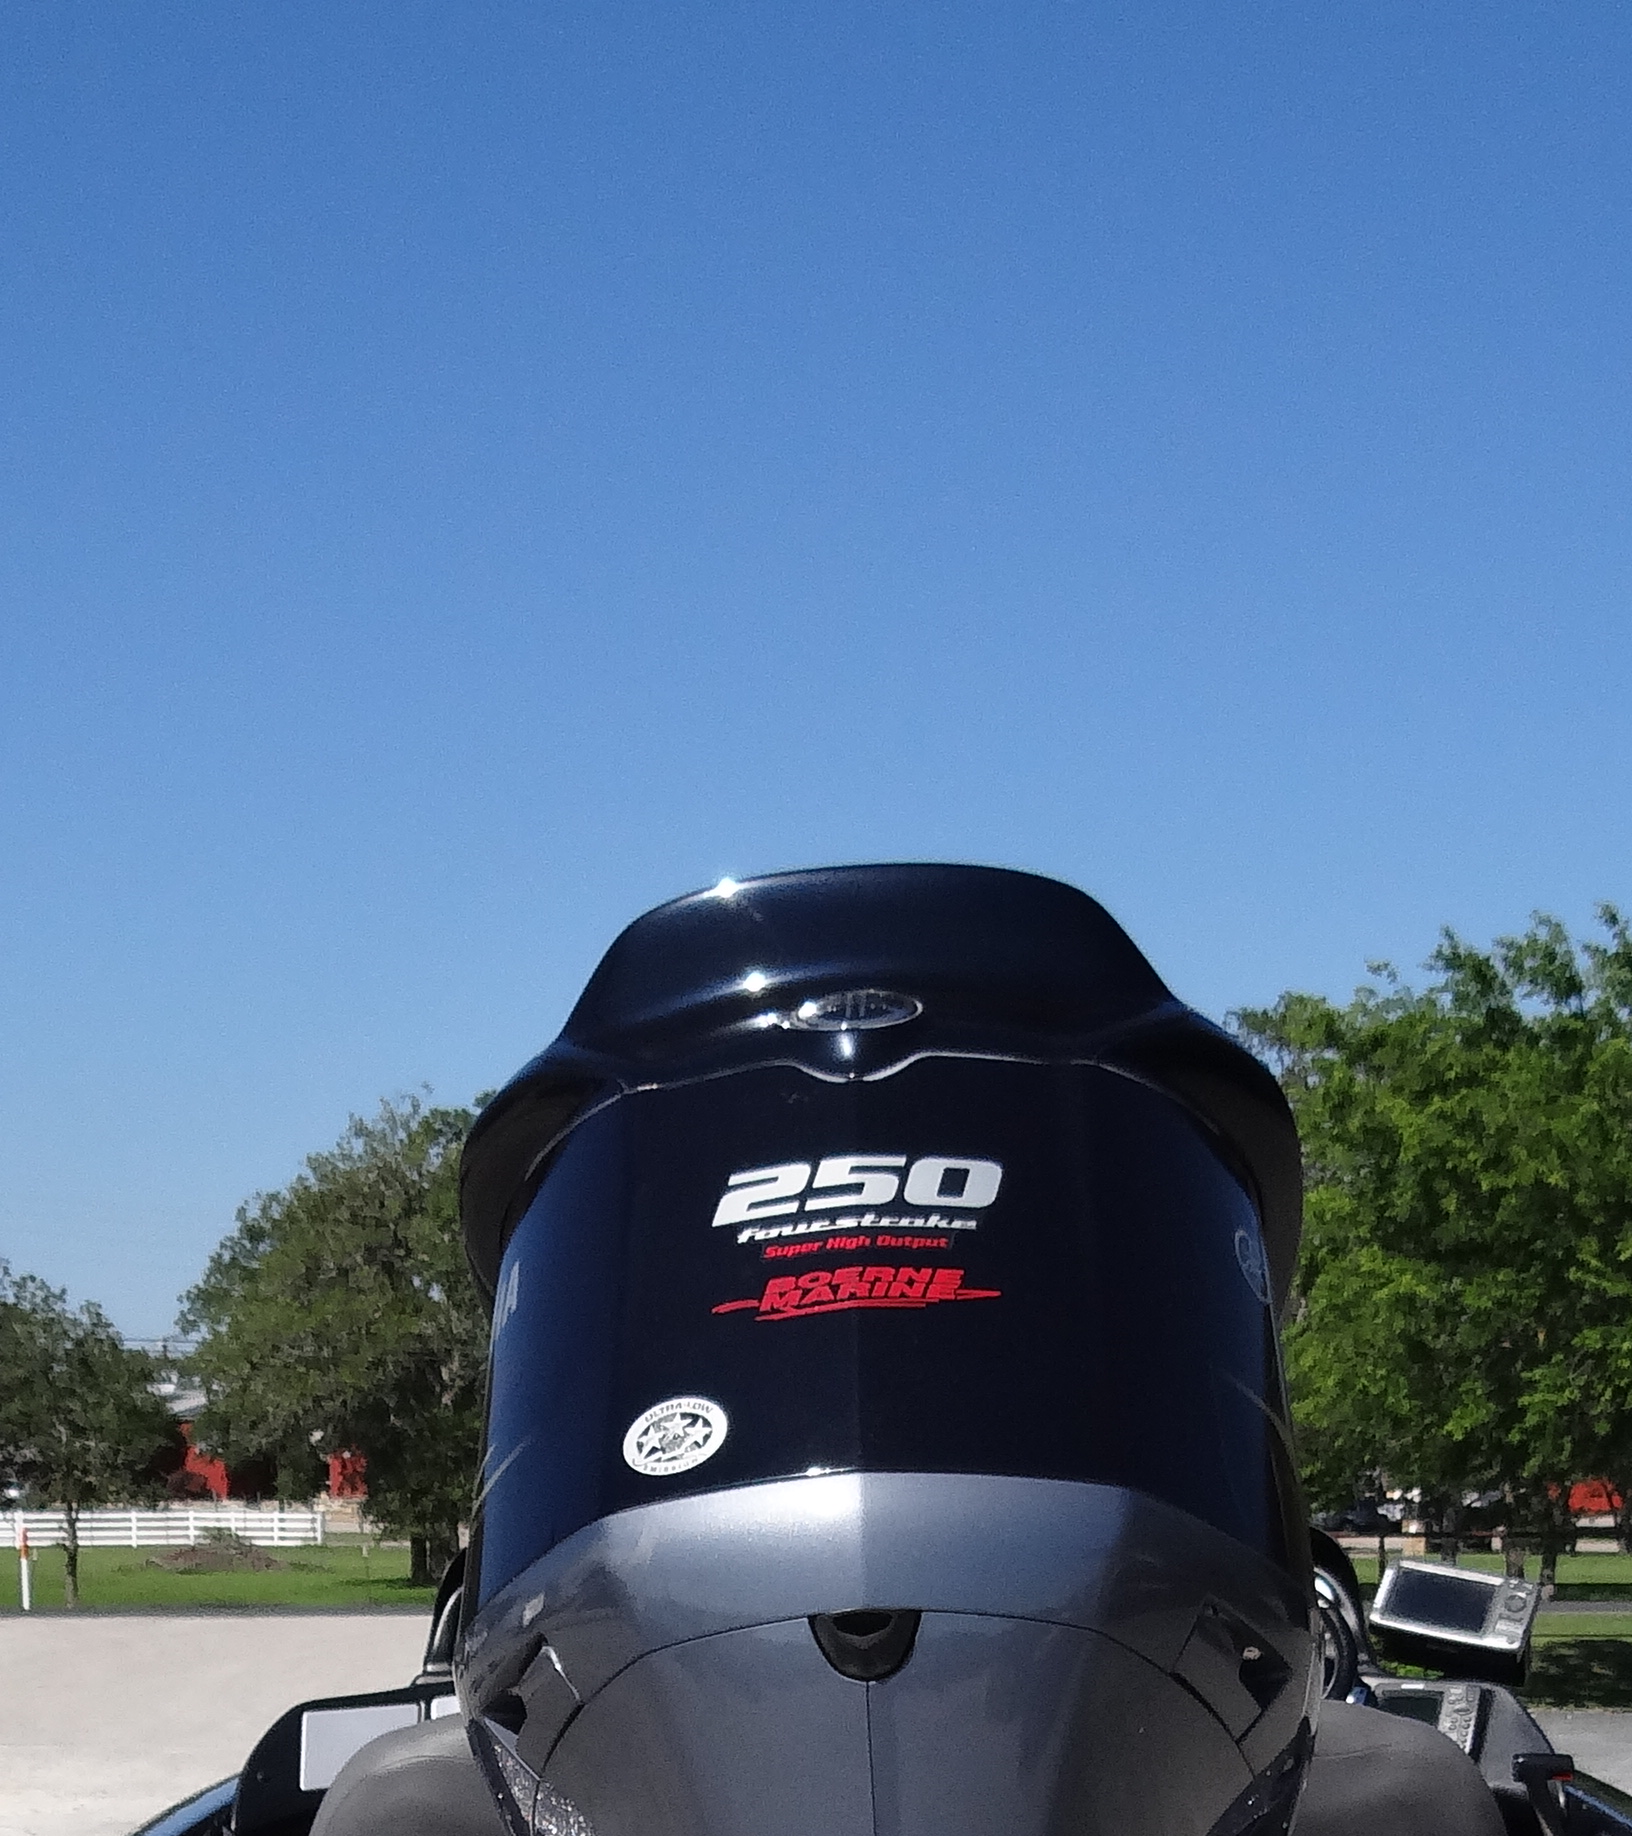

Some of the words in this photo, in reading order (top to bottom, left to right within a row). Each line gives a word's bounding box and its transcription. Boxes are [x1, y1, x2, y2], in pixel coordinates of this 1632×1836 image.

[712, 1155, 1003, 1228] 250
[762, 1240, 823, 1259] Super
[826, 1234, 871, 1250] High
[876, 1234, 949, 1250] Output
[759, 1281, 957, 1313] MARINE
[764, 1266, 965, 1297] BOERNE
